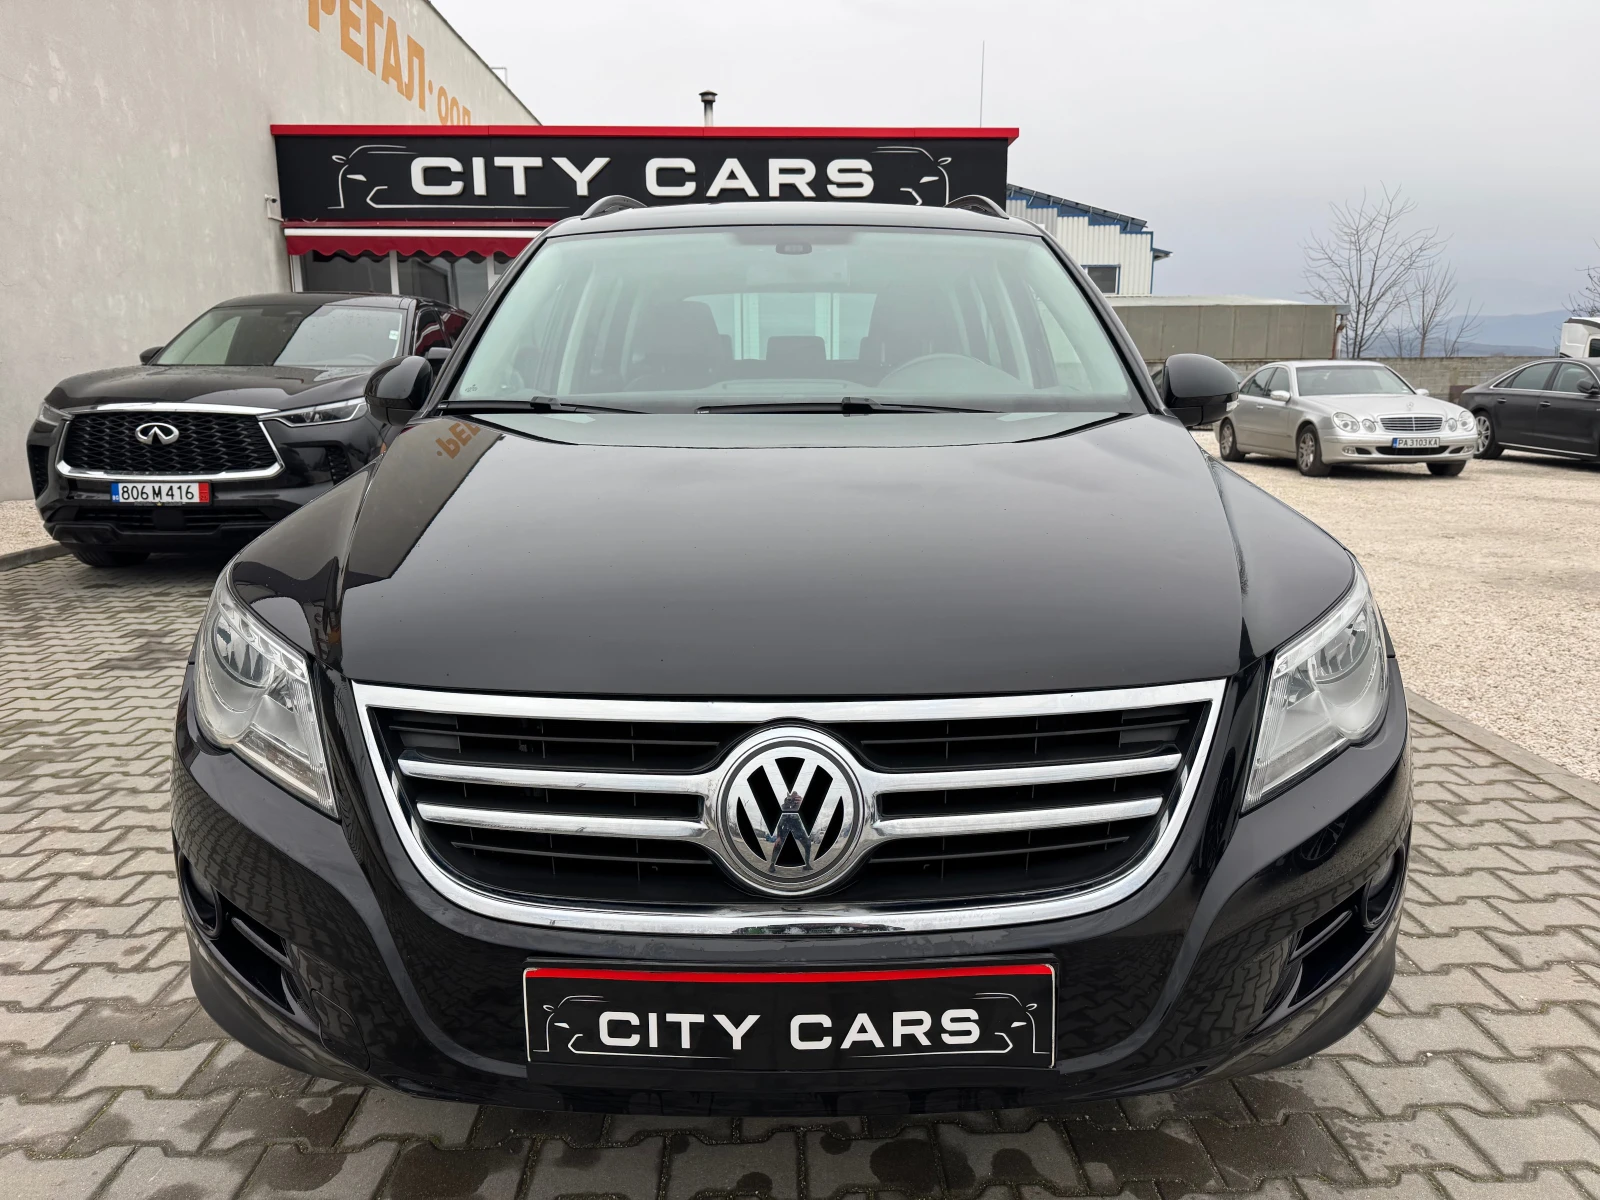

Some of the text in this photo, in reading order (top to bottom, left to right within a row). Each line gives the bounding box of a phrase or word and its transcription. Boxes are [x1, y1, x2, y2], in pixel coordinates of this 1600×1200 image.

[410, 156, 875, 198] CITY CARS
[121, 485, 149, 501] 806
[152, 485, 162, 500] M
[166, 485, 194, 500] 416
[598, 1008, 981, 1050] CITY CARS
